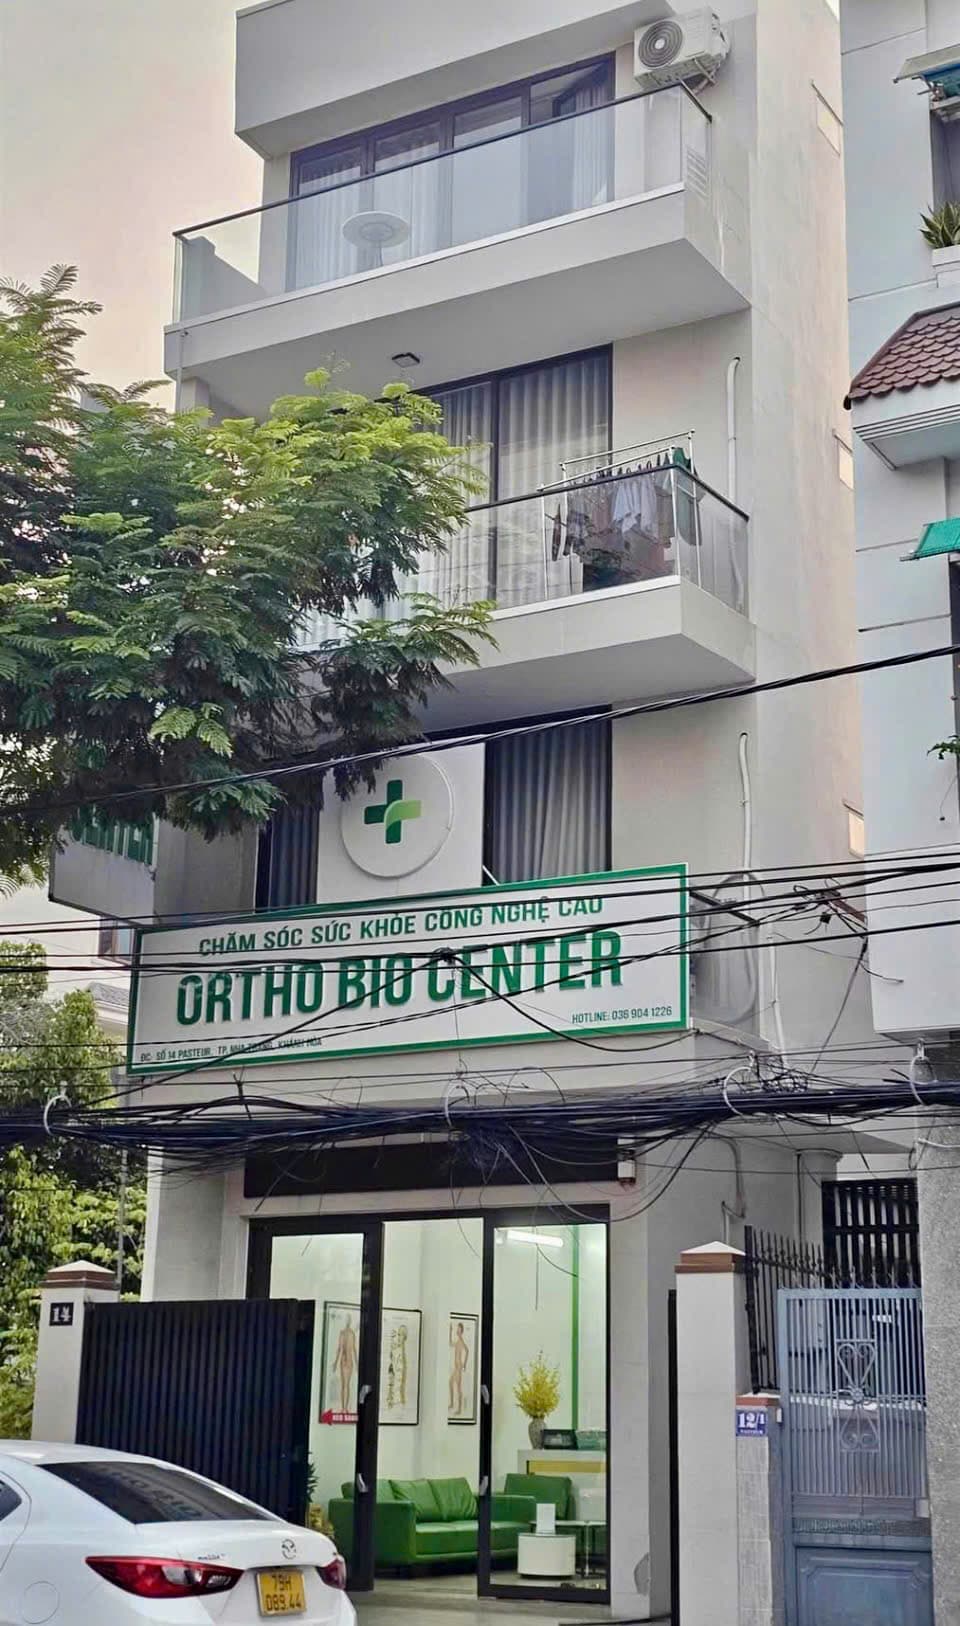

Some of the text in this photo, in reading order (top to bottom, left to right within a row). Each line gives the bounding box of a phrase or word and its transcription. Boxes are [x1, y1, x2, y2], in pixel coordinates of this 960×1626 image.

[199, 931, 256, 956] CHĂM
[263, 925, 303, 949] SÓC
[311, 919, 351, 944] SỨC
[176, 928, 623, 1025] ORTHO BIO CENTER
[572, 1011, 610, 1024] HOTLINE:
[631, 1007, 650, 1019] 904
[651, 1005, 673, 1018] 1226
[53, 1306, 72, 1322] 14
